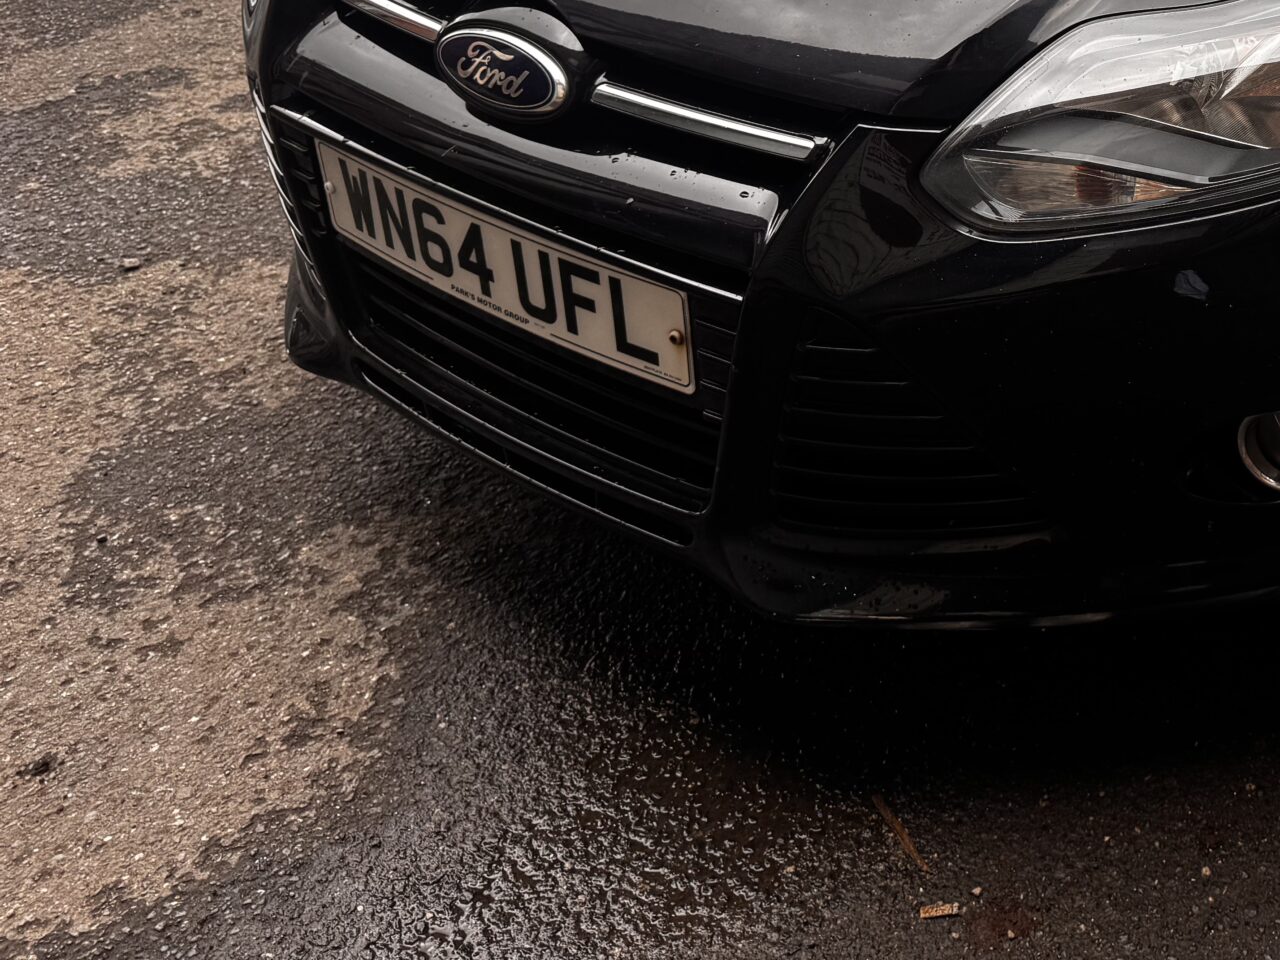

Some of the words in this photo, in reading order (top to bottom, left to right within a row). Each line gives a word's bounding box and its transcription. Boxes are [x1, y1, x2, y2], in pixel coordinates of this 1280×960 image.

[457, 41, 530, 98] Ford
[338, 157, 494, 298] WN64
[511, 238, 660, 367] UFL
[450, 283, 476, 301] PARK'S
[476, 296, 503, 313] MOTOR
[503, 309, 530, 325] GROUP
